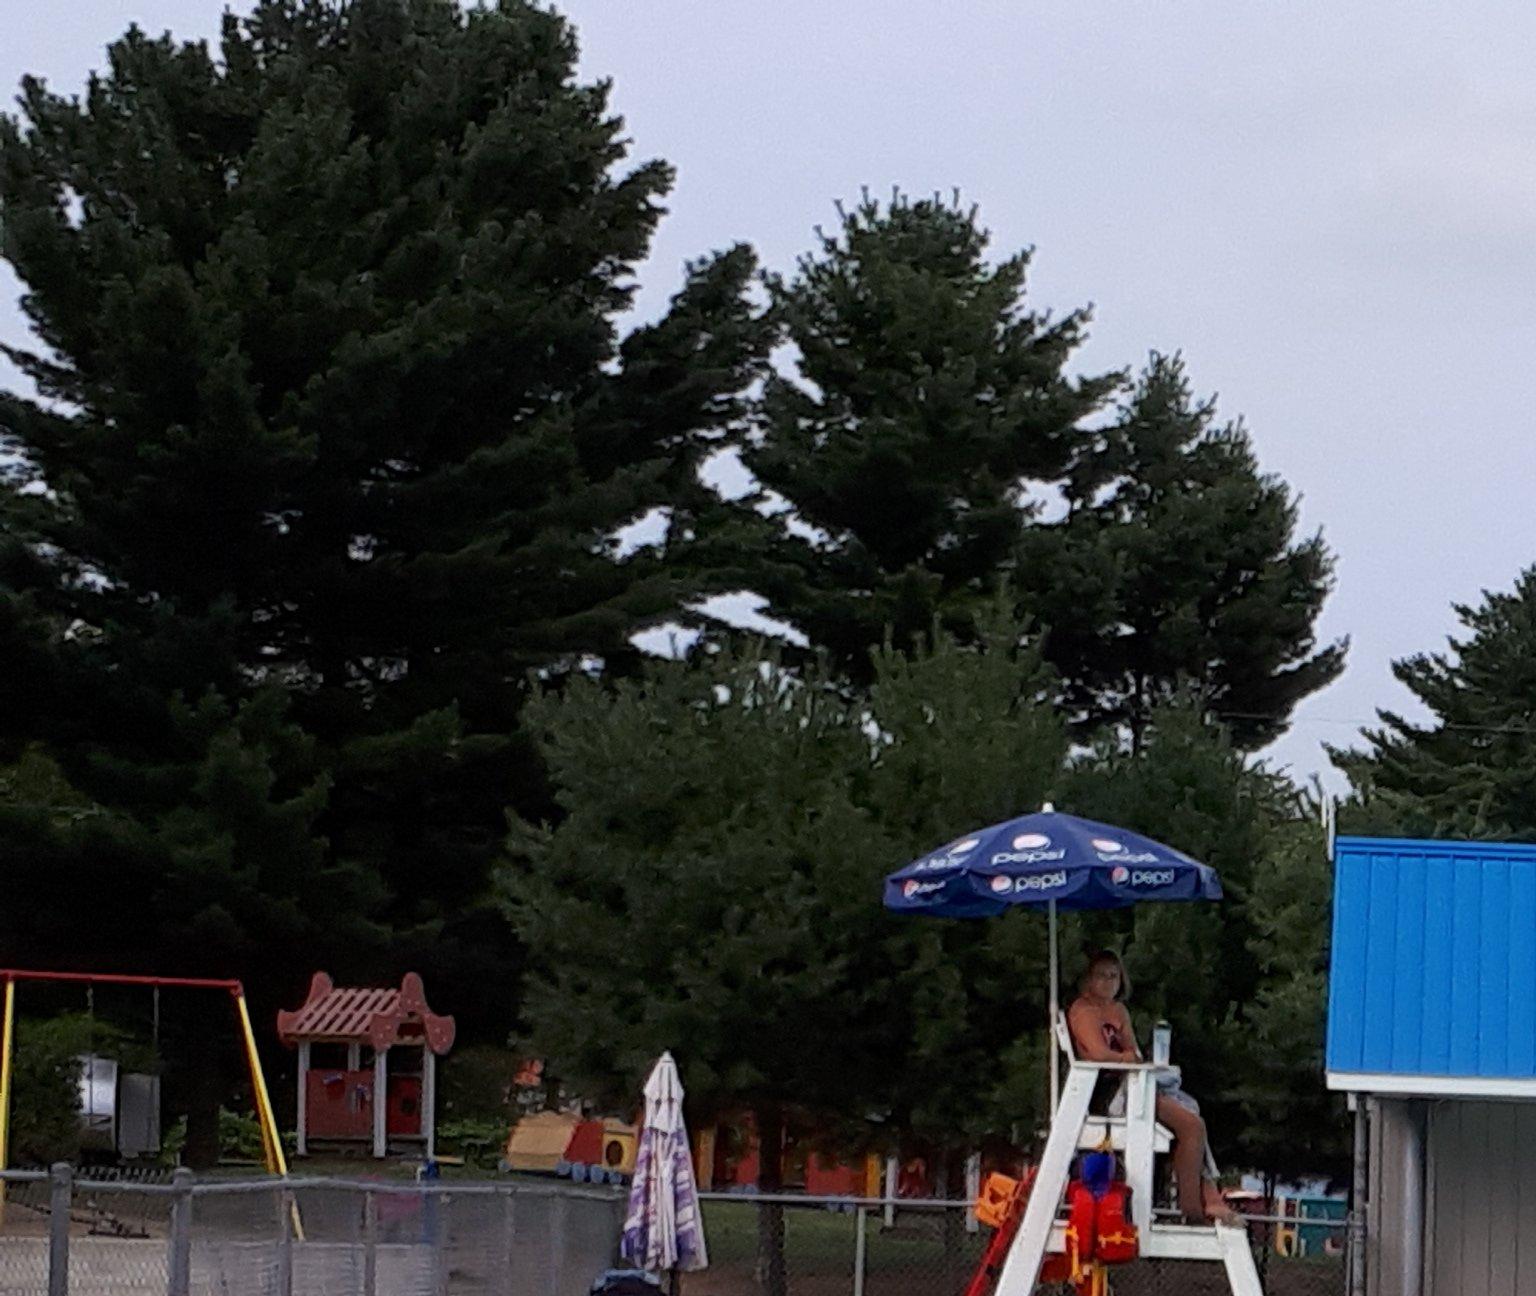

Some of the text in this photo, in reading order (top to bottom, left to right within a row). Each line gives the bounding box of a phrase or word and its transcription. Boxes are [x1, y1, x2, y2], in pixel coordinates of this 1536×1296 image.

[991, 849, 1065, 865] pepsi
[1015, 870, 1067, 893] pepsi
[1131, 868, 1175, 886] pepsi
